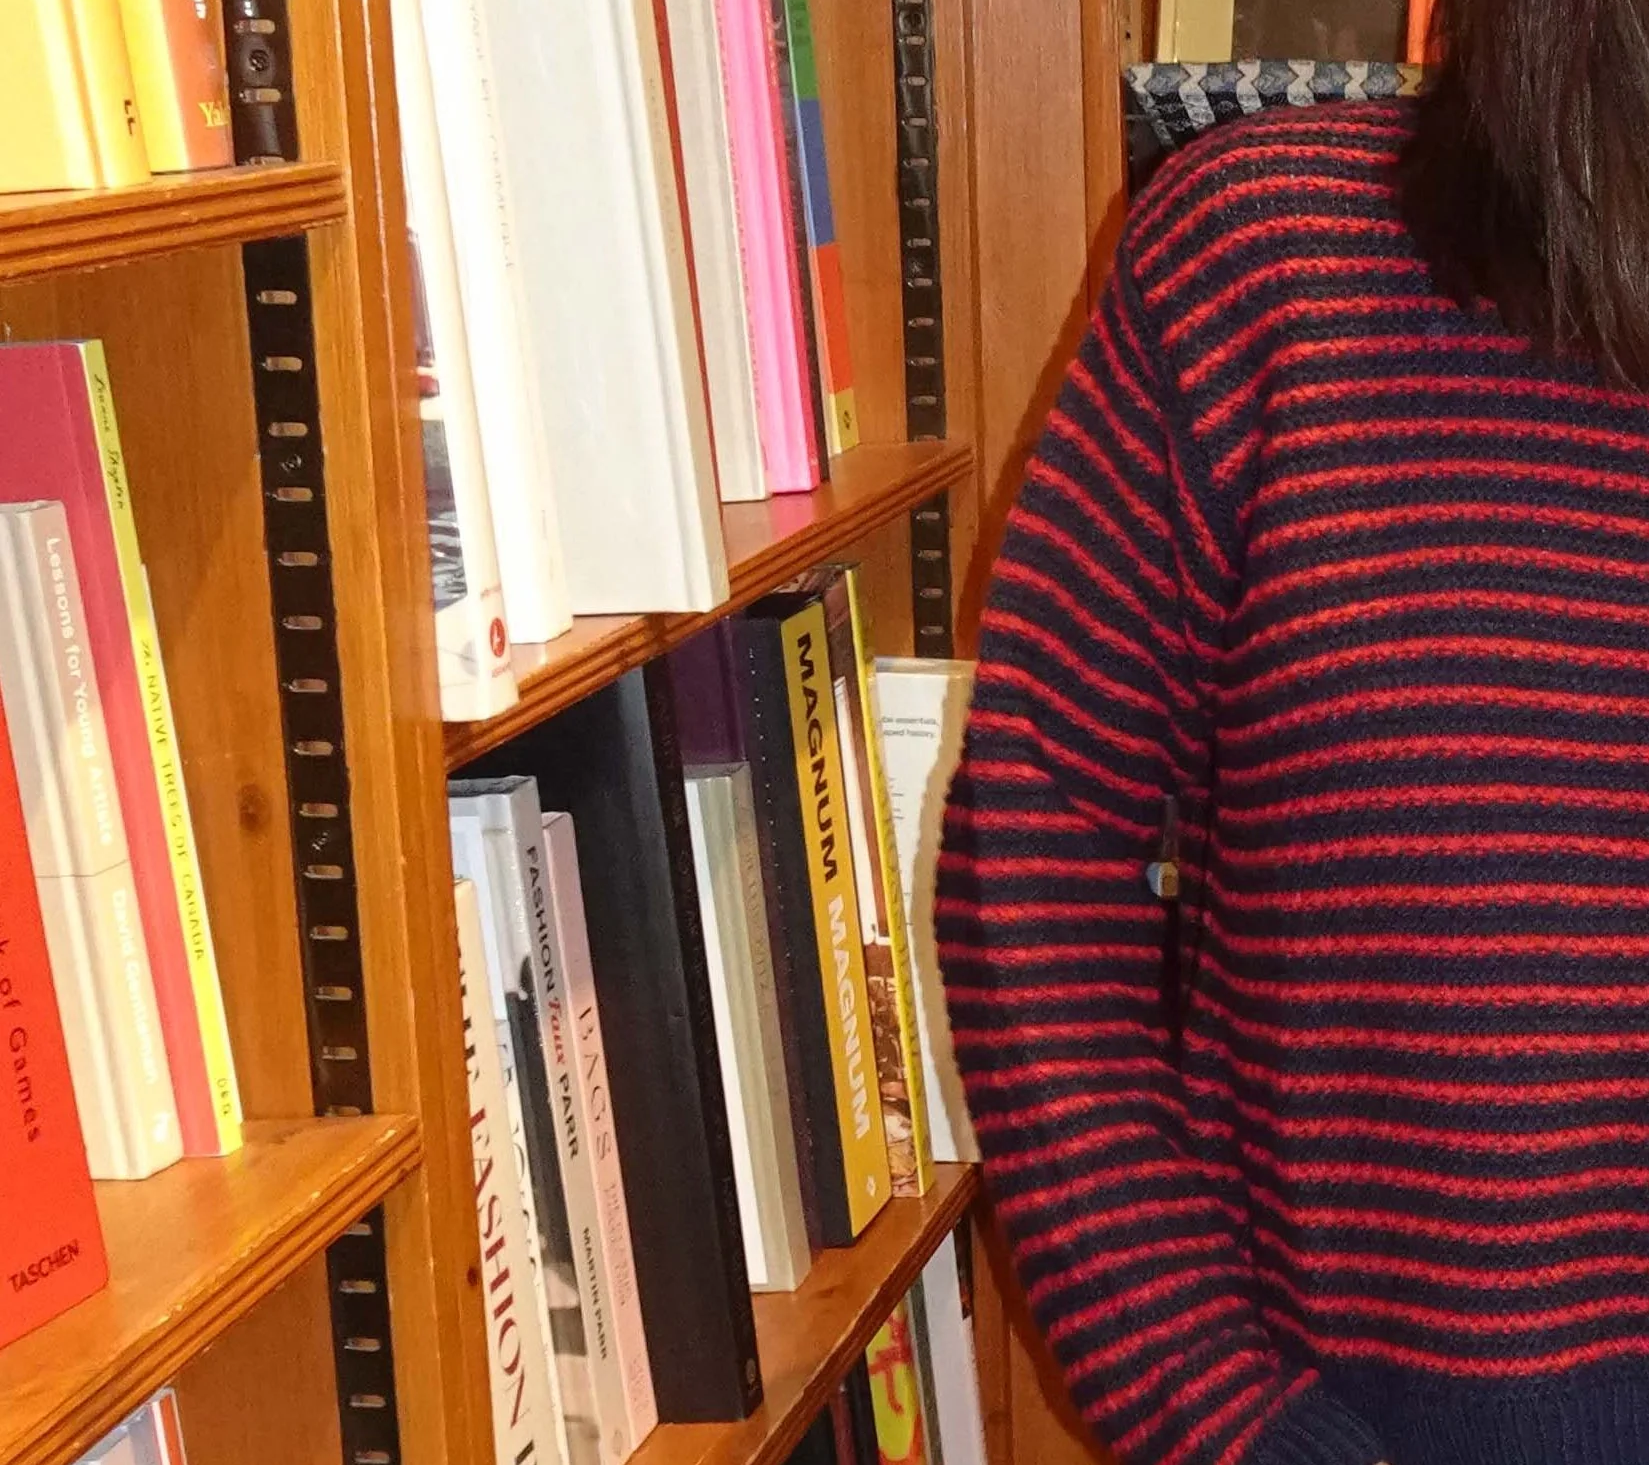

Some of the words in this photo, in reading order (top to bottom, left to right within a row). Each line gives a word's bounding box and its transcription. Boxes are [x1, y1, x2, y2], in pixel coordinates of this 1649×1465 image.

[45, 536, 87, 638] Lessons
[66, 644, 91, 677] for
[70, 682, 98, 758] Young
[89, 766, 115, 846] Artists
[146, 673, 170, 746] NATIVE
[161, 762, 183, 827] TREES
[174, 835, 189, 858] OF
[182, 873, 207, 960] CANADA
[111, 888, 140, 955] David
[798, 634, 839, 883] MAGNUM
[828, 894, 871, 1141] MAGNUM
[0, 977, 22, 1009] of
[123, 961, 161, 1084] Gentleman
[525, 845, 557, 992] FASHION
[547, 996, 567, 1064] Faux
[557, 1072, 580, 1160] PARR
[9, 1026, 41, 1143] Games
[579, 1005, 612, 1163] BAGS
[8, 1238, 80, 1293] TASCHEN
[467, 1106, 530, 1429] FASHION
[582, 1227, 601, 1303] MARTIN
[593, 1308, 609, 1359] PARR
